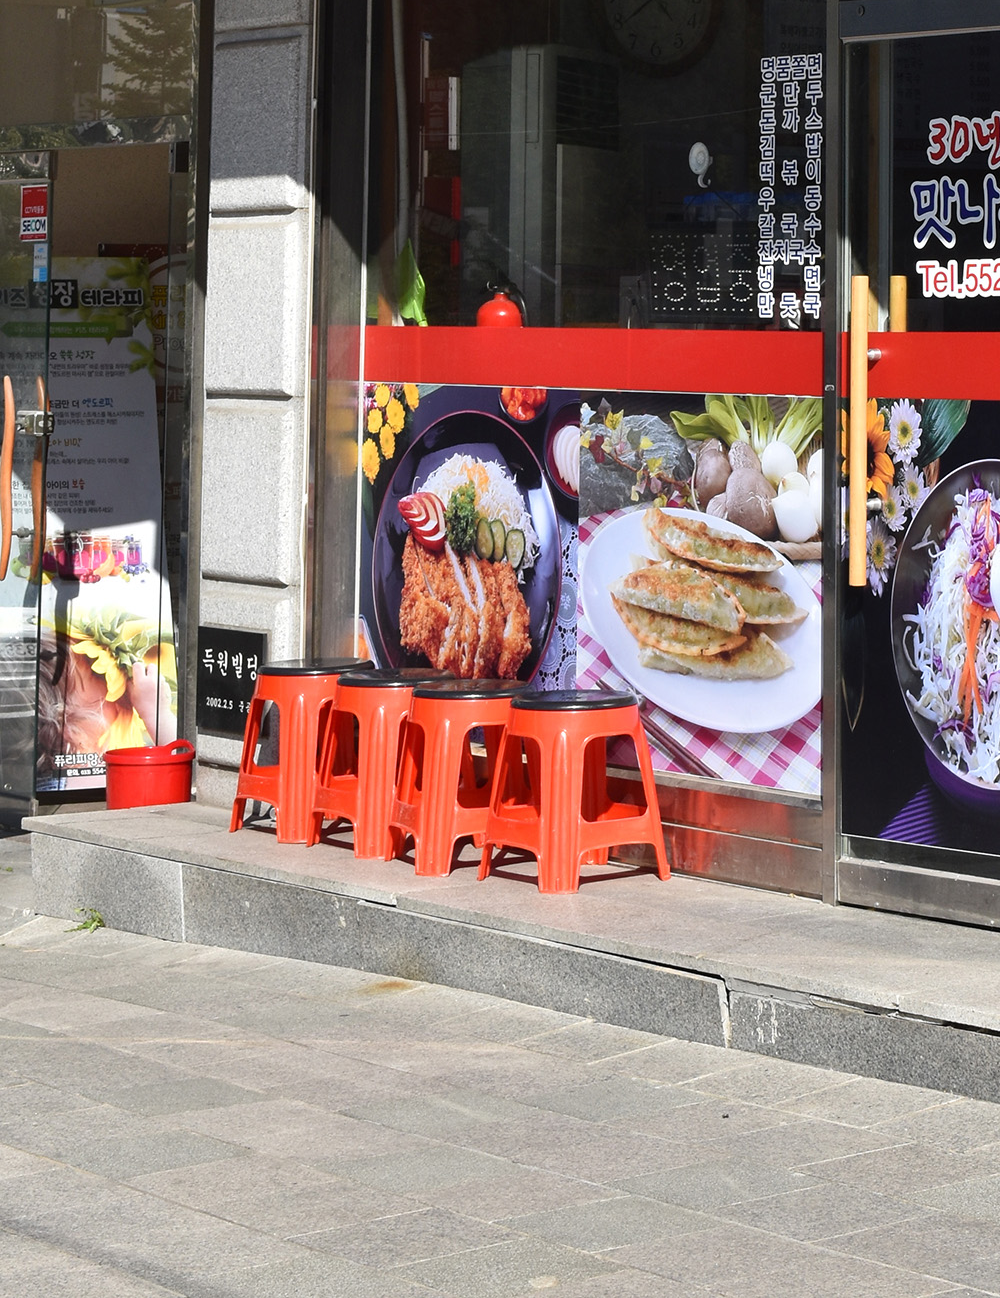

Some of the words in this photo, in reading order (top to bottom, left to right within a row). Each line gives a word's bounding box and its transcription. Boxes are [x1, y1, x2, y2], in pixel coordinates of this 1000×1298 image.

[761, 53, 822, 82] 명품쫄면
[760, 80, 823, 108] 군만두
[759, 107, 822, 133] 돈까스
[760, 132, 823, 160] 김밥
[759, 158, 821, 185] 떡볶이
[758, 185, 822, 212] 우동
[22, 219, 46, 232] SECOM
[758, 213, 821, 238] 칼국수
[757, 239, 821, 265] 잔치국수
[660, 243, 753, 303] 영업중
[757, 265, 821, 291] 냉면
[80, 288, 144, 307] 테라피
[75, 350, 95, 360] 성장
[72, 400, 80, 409] 더
[64, 438, 82, 447] 비만
[47, 480, 70, 490] 아이의
[72, 478, 85, 490] 보습
[202, 648, 258, 681] 득원빌딩
[206, 696, 233, 710] 2002.2.5
[55, 753, 99, 767] 퓨리피앙
